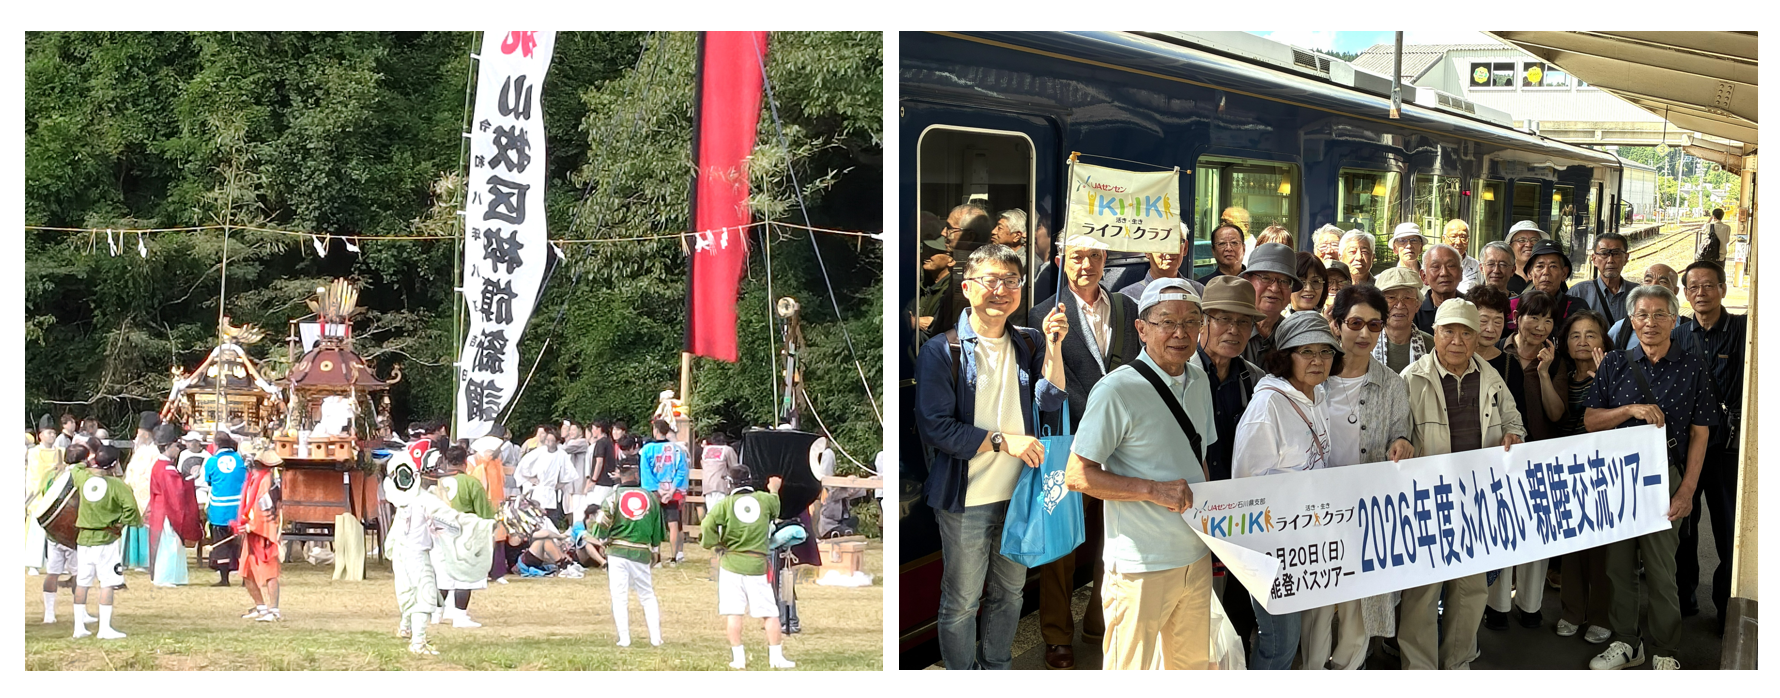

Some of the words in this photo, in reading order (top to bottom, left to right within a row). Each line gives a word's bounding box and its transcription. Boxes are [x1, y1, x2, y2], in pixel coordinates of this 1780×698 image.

[1358, 450, 1662, 573] 2026年度ふれあい親睦交流ツアー
[1265, 539, 1346, 571] 月20日(日)
[1270, 565, 1356, 600] 能登バスツアー
